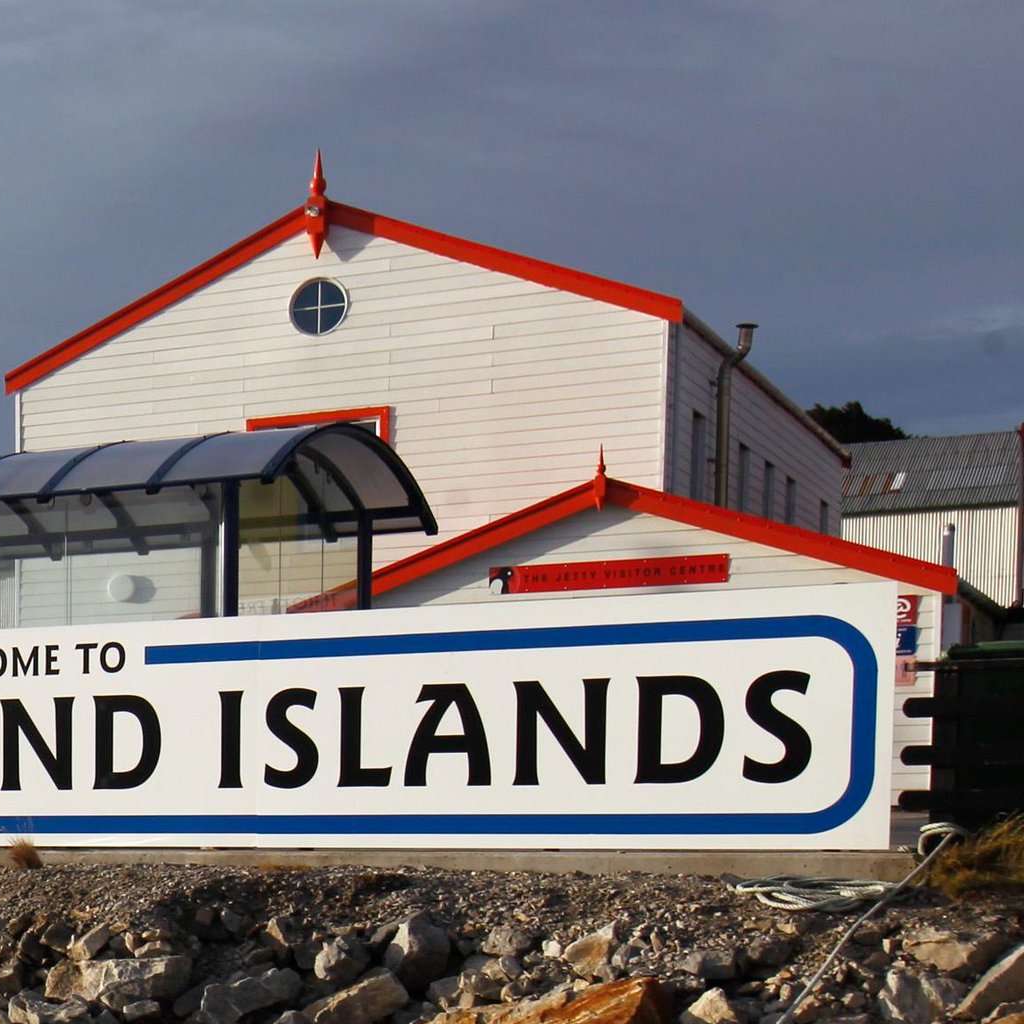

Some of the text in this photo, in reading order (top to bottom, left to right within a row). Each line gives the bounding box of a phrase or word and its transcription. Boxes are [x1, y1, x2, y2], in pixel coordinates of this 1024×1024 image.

[523, 562, 726, 584] THE JETTY VISITOR CENTRE
[74, 641, 127, 675] TO
[217, 669, 813, 790] ISLANDS
